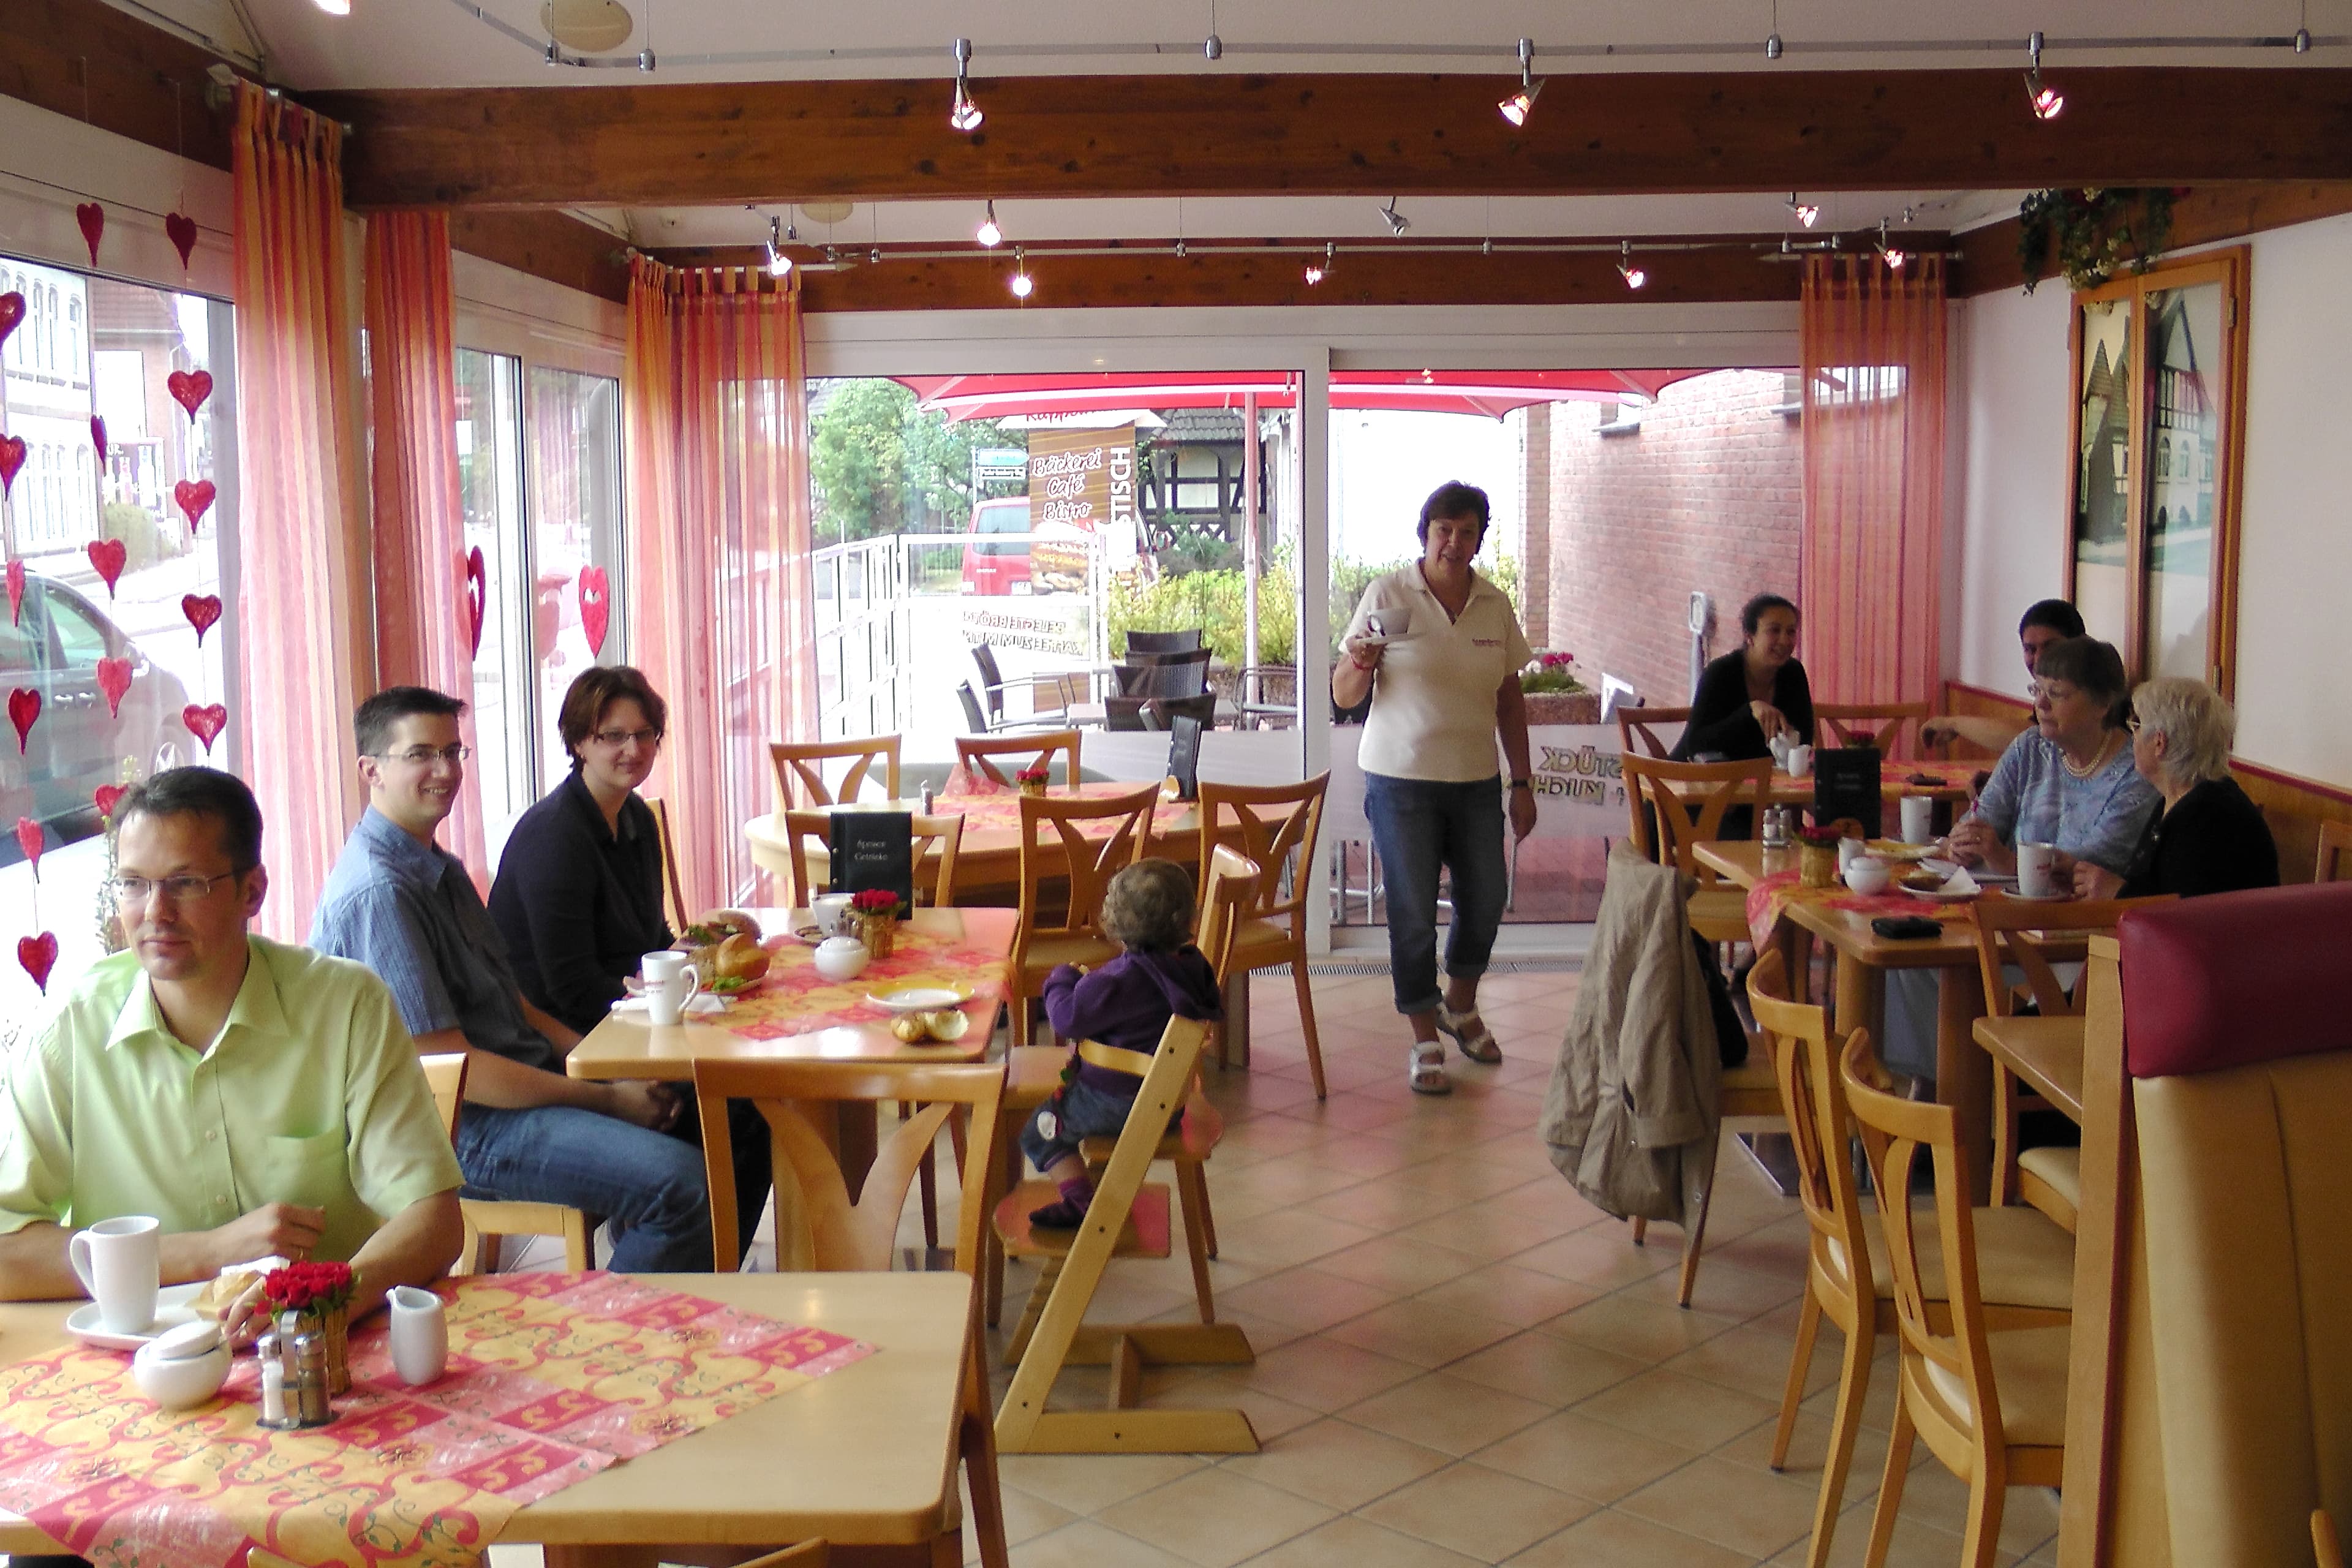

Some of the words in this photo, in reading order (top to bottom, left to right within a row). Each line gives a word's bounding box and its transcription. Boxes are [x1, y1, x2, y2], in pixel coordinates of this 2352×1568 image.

[1033, 448, 1102, 477] Bäckerei
[1047, 473, 1086, 500] Café
[1042, 500, 1093, 521] Bistro
